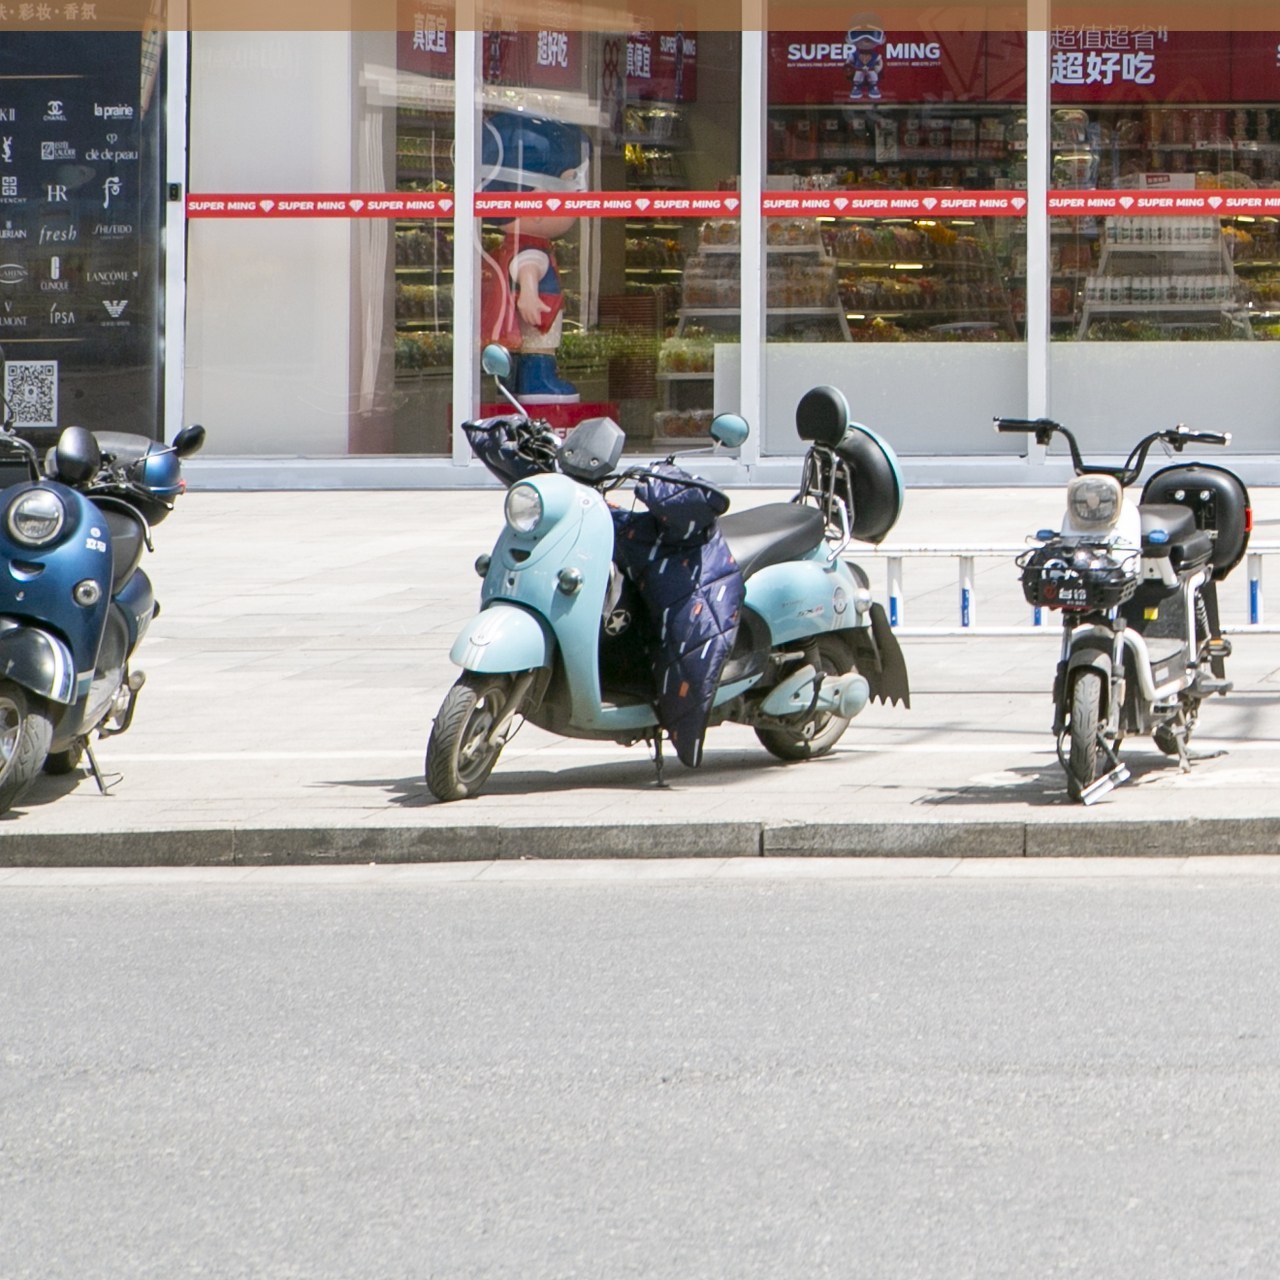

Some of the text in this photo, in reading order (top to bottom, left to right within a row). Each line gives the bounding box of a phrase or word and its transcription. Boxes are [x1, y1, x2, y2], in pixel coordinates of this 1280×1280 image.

[412, 11, 448, 54] 真便宜
[1051, 24, 1157, 51] 超值超省
[536, 30, 568, 68] 超好吃
[787, 42, 941, 60] SUPER MING
[1051, 51, 1157, 85] 超好吃
[103, 104, 133, 120] prairie
[115, 150, 138, 163] peau
[47, 185, 68, 202] HR
[188, 200, 436, 211] SUPER MING SUPER MING
[475, 199, 722, 210] SUPER MING SUPER MING
[762, 198, 1009, 209] SUPER MING SUPER MING
[1048, 198, 1085, 208] SUPER
[1087, 198, 1117, 208] MING
[1225, 197, 1262, 207] SUPER
[39, 224, 77, 245] fresh
[92, 224, 132, 235] SHISEIDO
[40, 281, 69, 291] CLINIQUE
